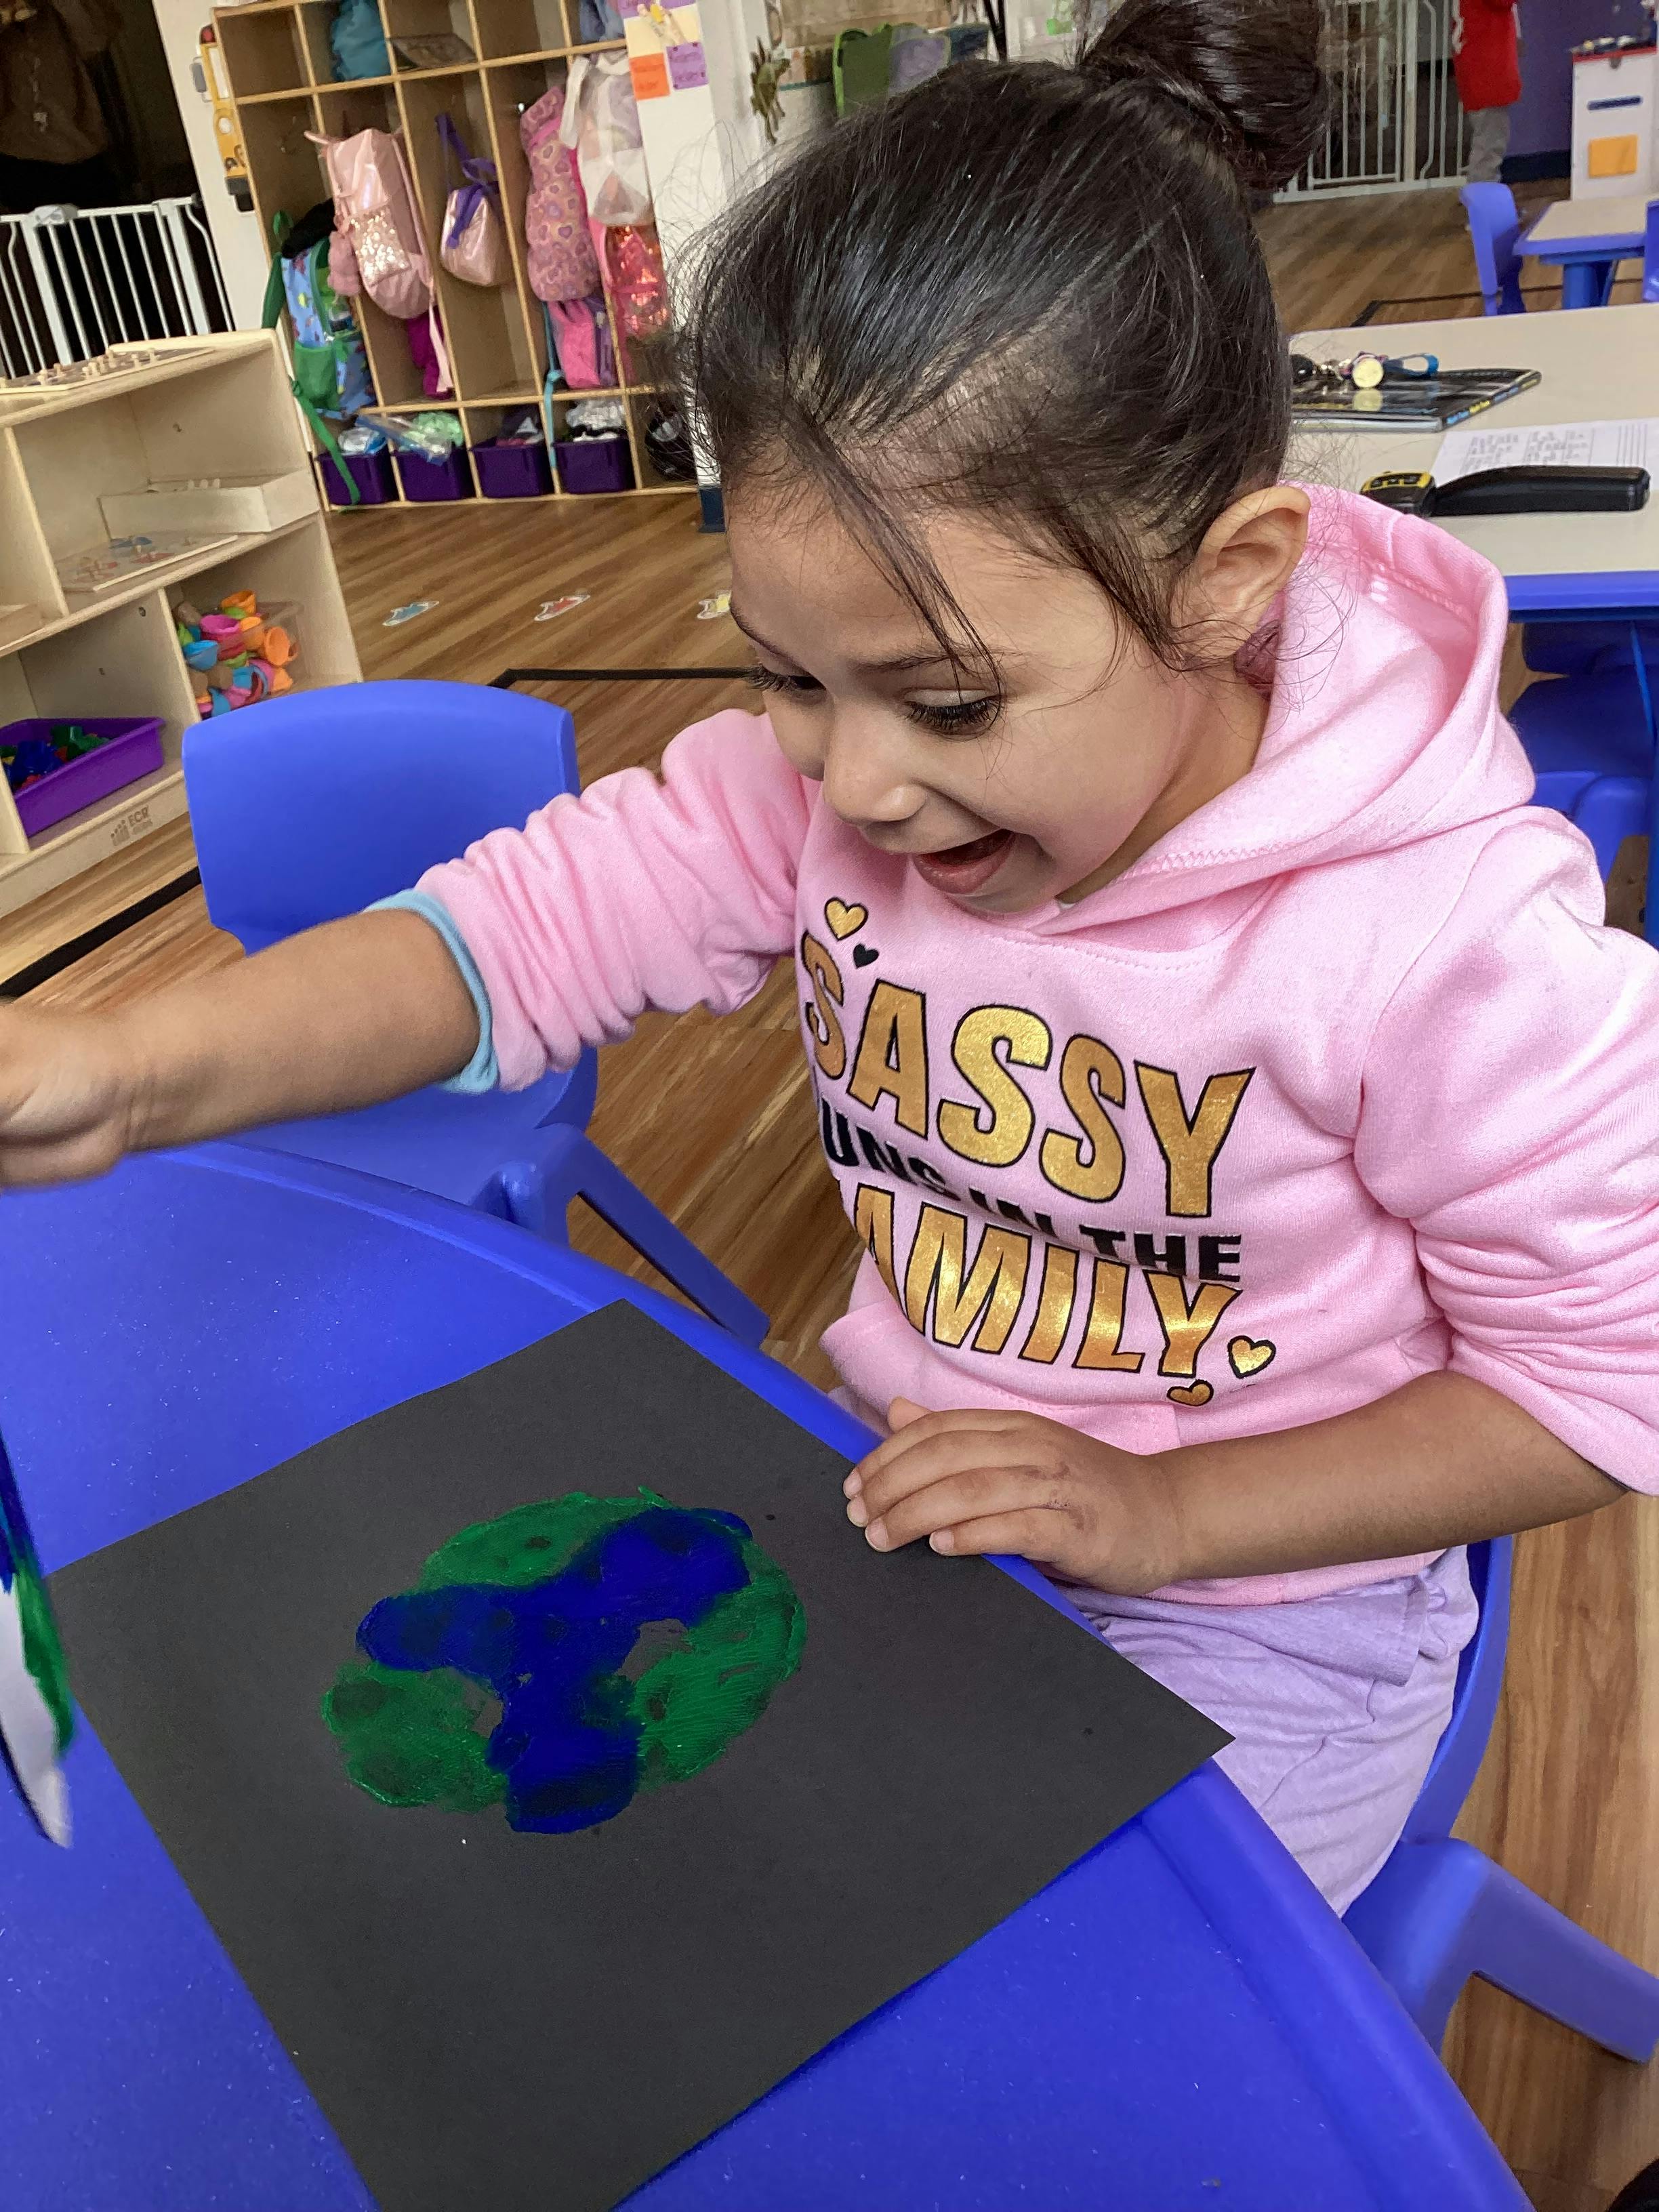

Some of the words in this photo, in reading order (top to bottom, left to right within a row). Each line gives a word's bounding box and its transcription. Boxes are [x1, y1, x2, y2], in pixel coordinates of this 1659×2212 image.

[800, 930, 1256, 1218] SASSY
[820, 1097, 961, 1201] UNS
[1079, 1223, 1242, 1283] THE
[853, 1182, 1242, 1377] AMILY
